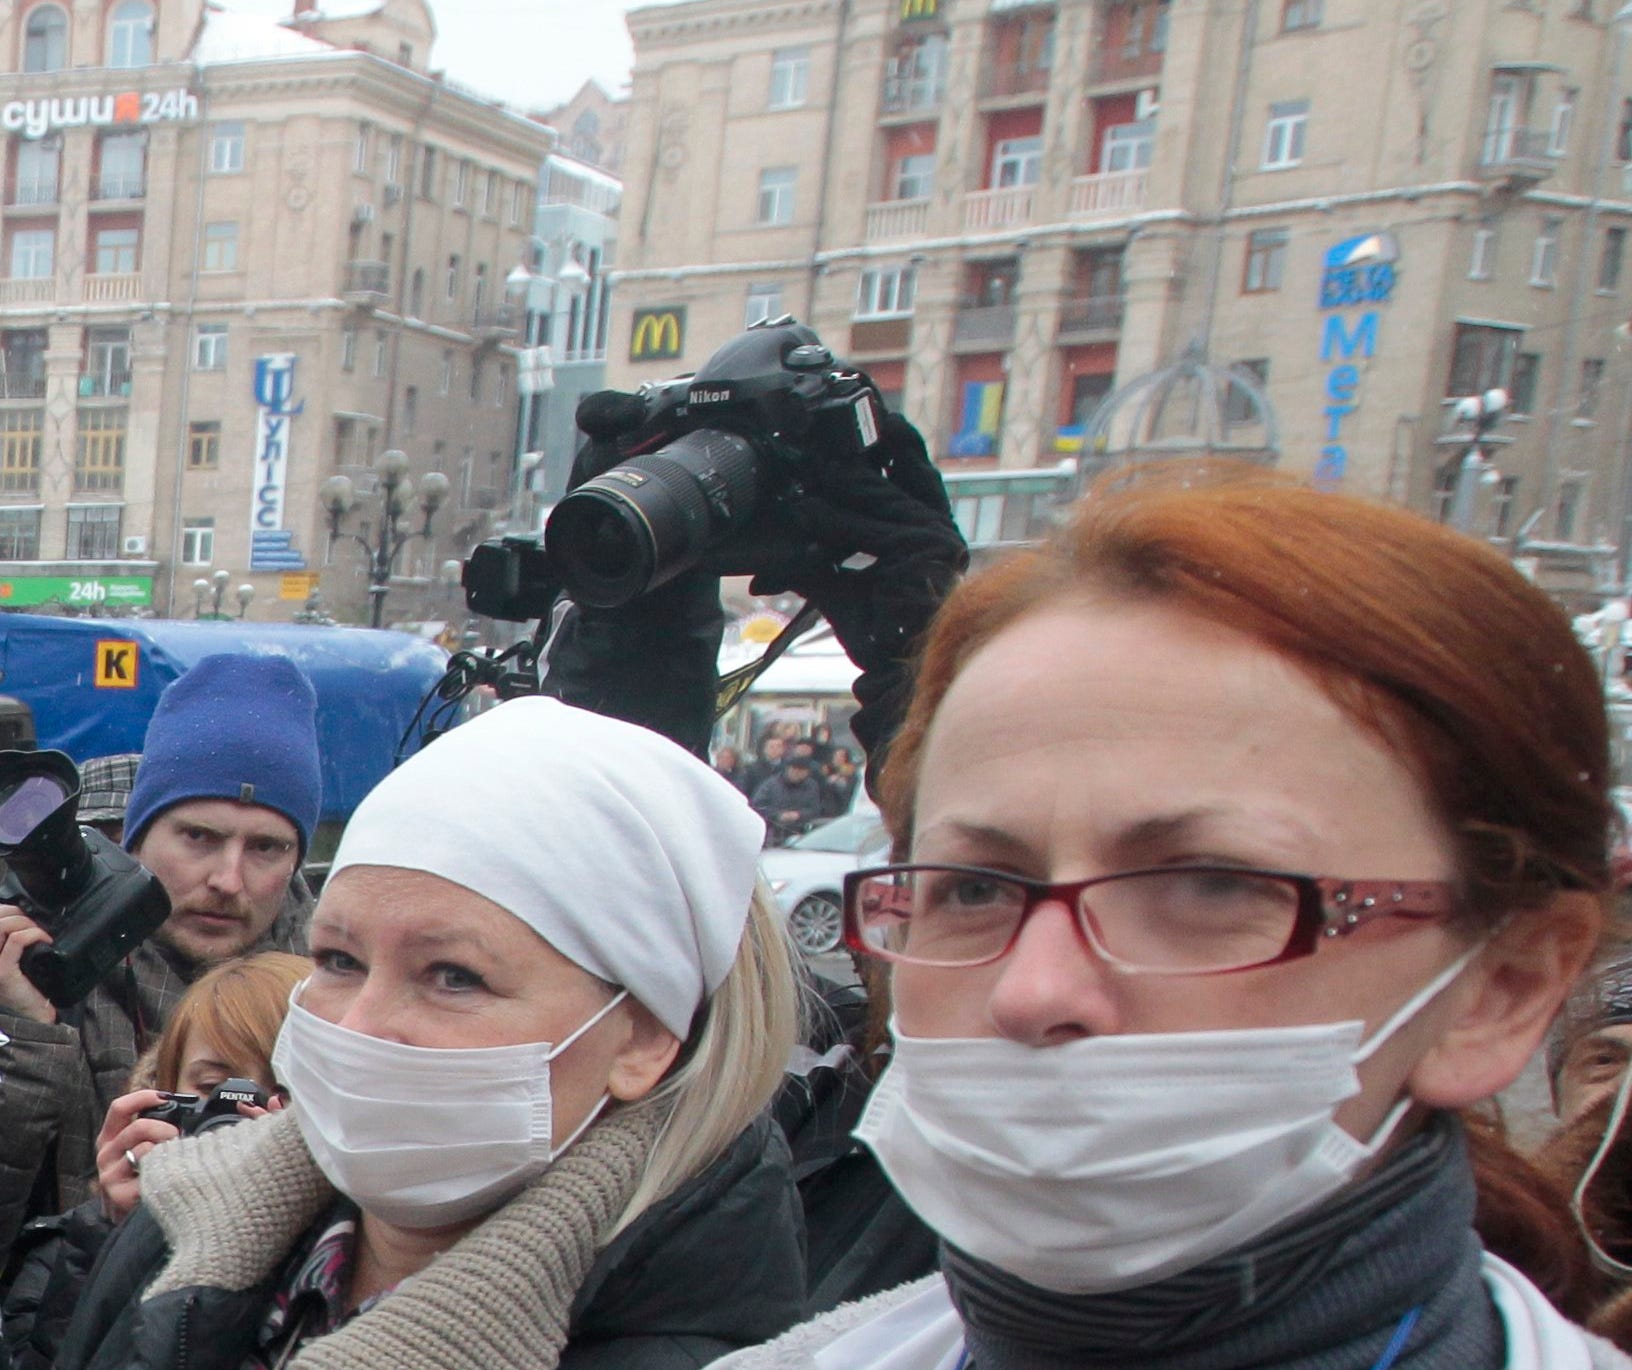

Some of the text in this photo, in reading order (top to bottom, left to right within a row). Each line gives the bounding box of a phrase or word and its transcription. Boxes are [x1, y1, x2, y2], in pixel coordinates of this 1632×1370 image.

[142, 88, 199, 122] 24h
[689, 389, 730, 404] Nikon
[69, 581, 106, 601] 24h
[104, 648, 129, 680] К
[219, 1091, 255, 1102] PENTAX
